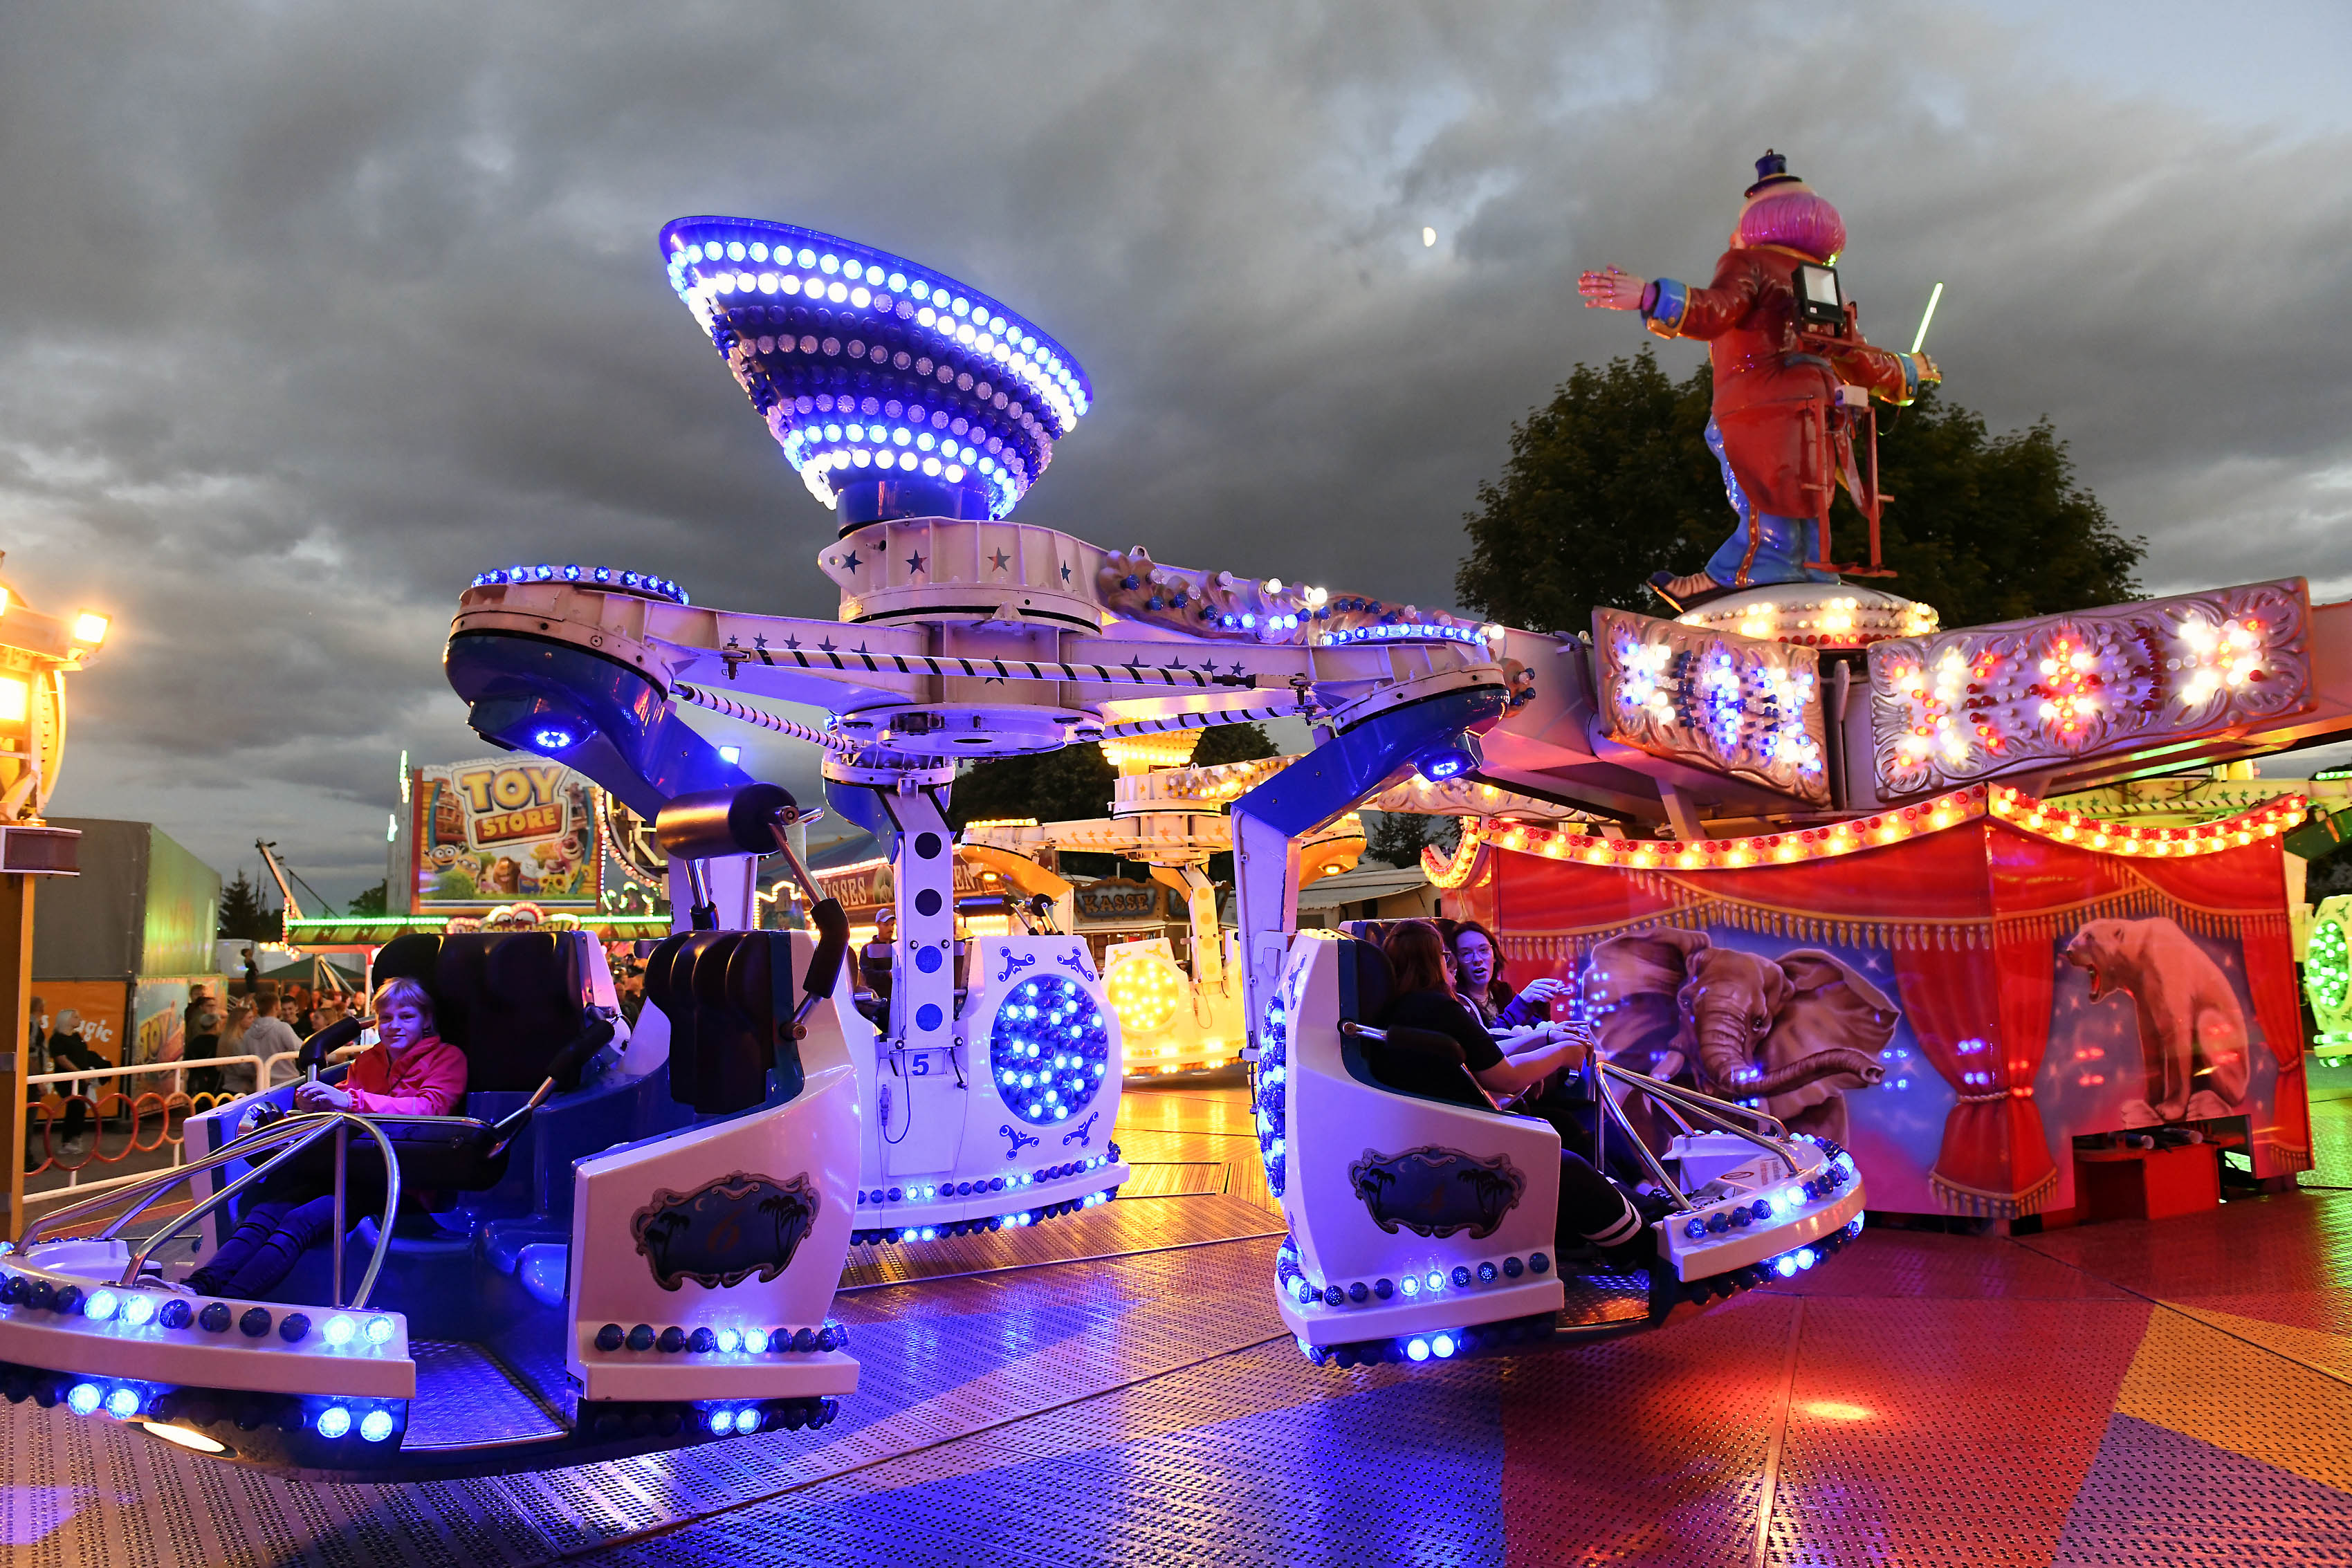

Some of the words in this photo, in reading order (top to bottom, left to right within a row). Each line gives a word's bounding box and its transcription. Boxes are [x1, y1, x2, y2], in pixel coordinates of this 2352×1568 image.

[461, 766, 562, 813] TOY
[484, 807, 556, 837] STORE
[822, 876, 867, 906] ÜSSES
[1082, 893, 1148, 914] KASSE
[74, 1019, 113, 1042] agic
[912, 1053, 930, 1076] 5
